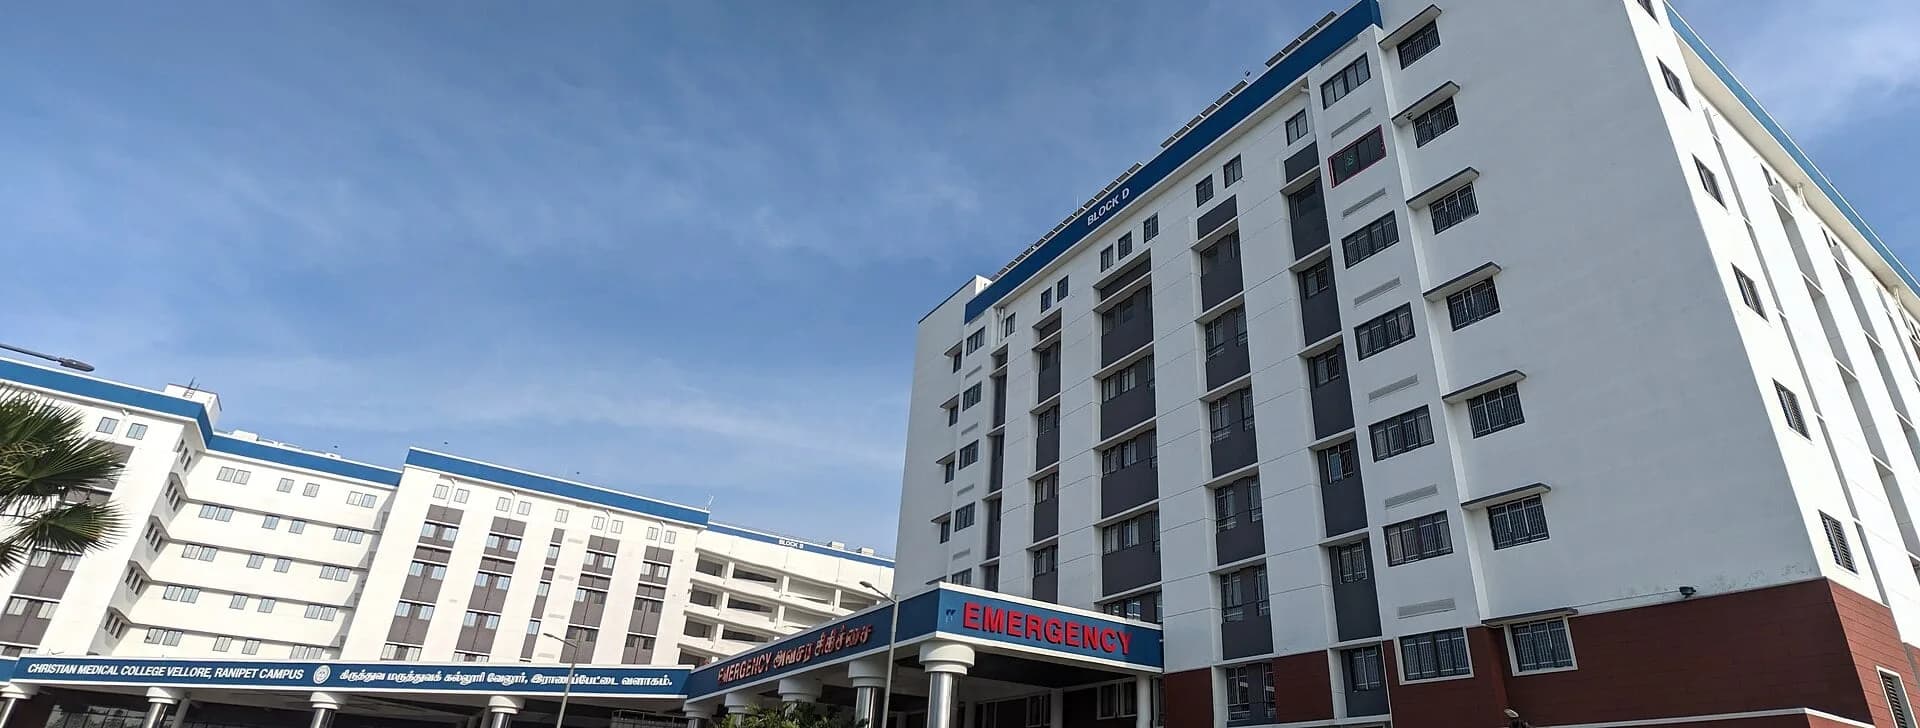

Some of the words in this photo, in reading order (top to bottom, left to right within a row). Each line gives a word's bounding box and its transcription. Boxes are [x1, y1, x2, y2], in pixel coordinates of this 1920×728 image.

[1087, 195, 1119, 226] BLOCK
[1122, 187, 1130, 200] D
[778, 538, 799, 549] BLOCK
[962, 600, 1134, 656] EMERGENCY
[27, 663, 78, 674] CHRISTIAN
[77, 664, 120, 676] MEDICAL
[120, 665, 168, 677] COLLEGE
[167, 666, 213, 679] VELLORE,
[214, 667, 260, 678] RANIPET
[259, 668, 305, 680] CAMPUS
[530, 673, 619, 686] இராணப்பேட்டை
[717, 651, 772, 684] EMERGENCY
